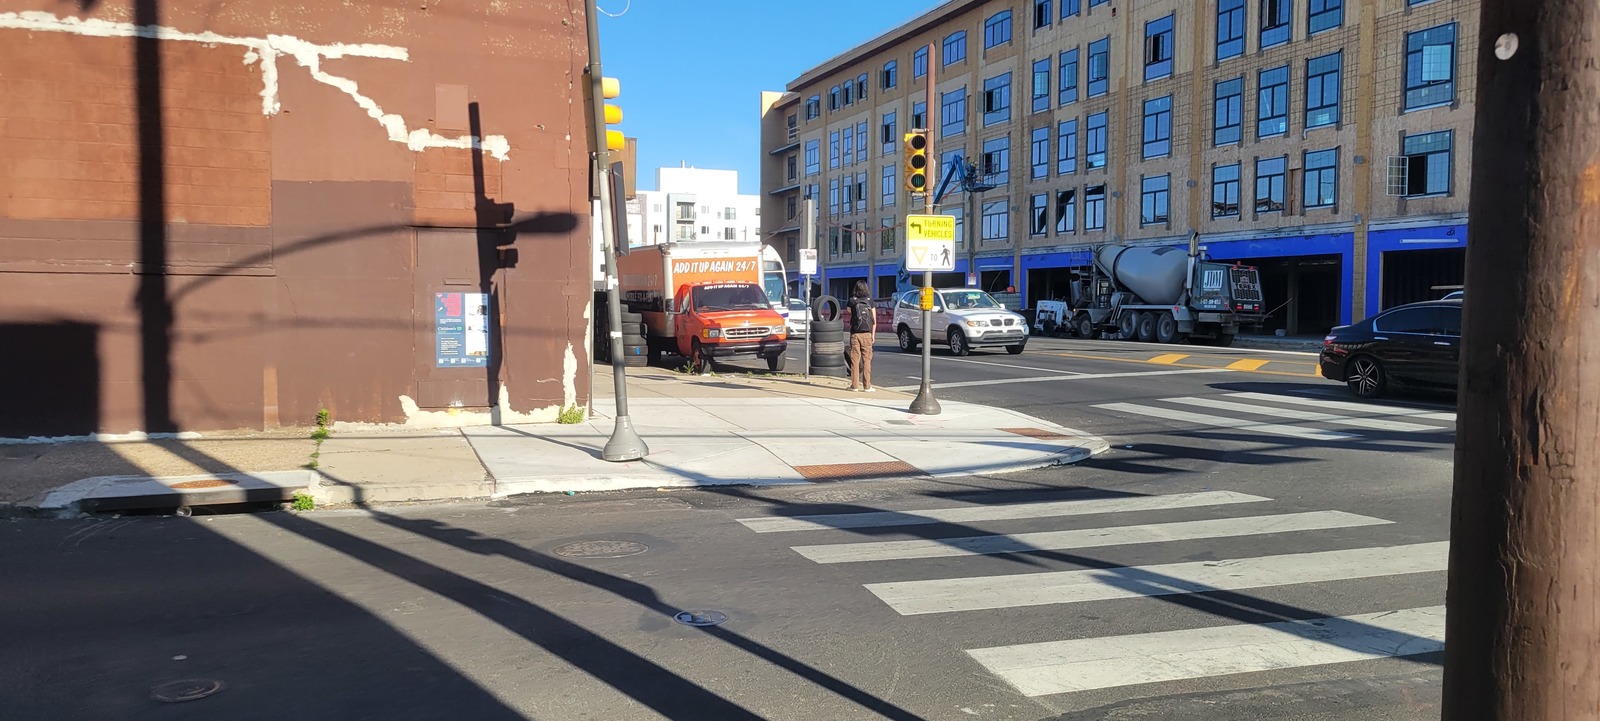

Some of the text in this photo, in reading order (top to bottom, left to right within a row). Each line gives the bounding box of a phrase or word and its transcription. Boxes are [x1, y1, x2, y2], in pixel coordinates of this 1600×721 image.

[923, 219, 953, 228] TURNING
[923, 230, 953, 238] VEHICLES
[930, 253, 938, 261] TO
[674, 260, 756, 274] ADD IT UP AGAIN 24/7
[1204, 271, 1222, 288] JDM
